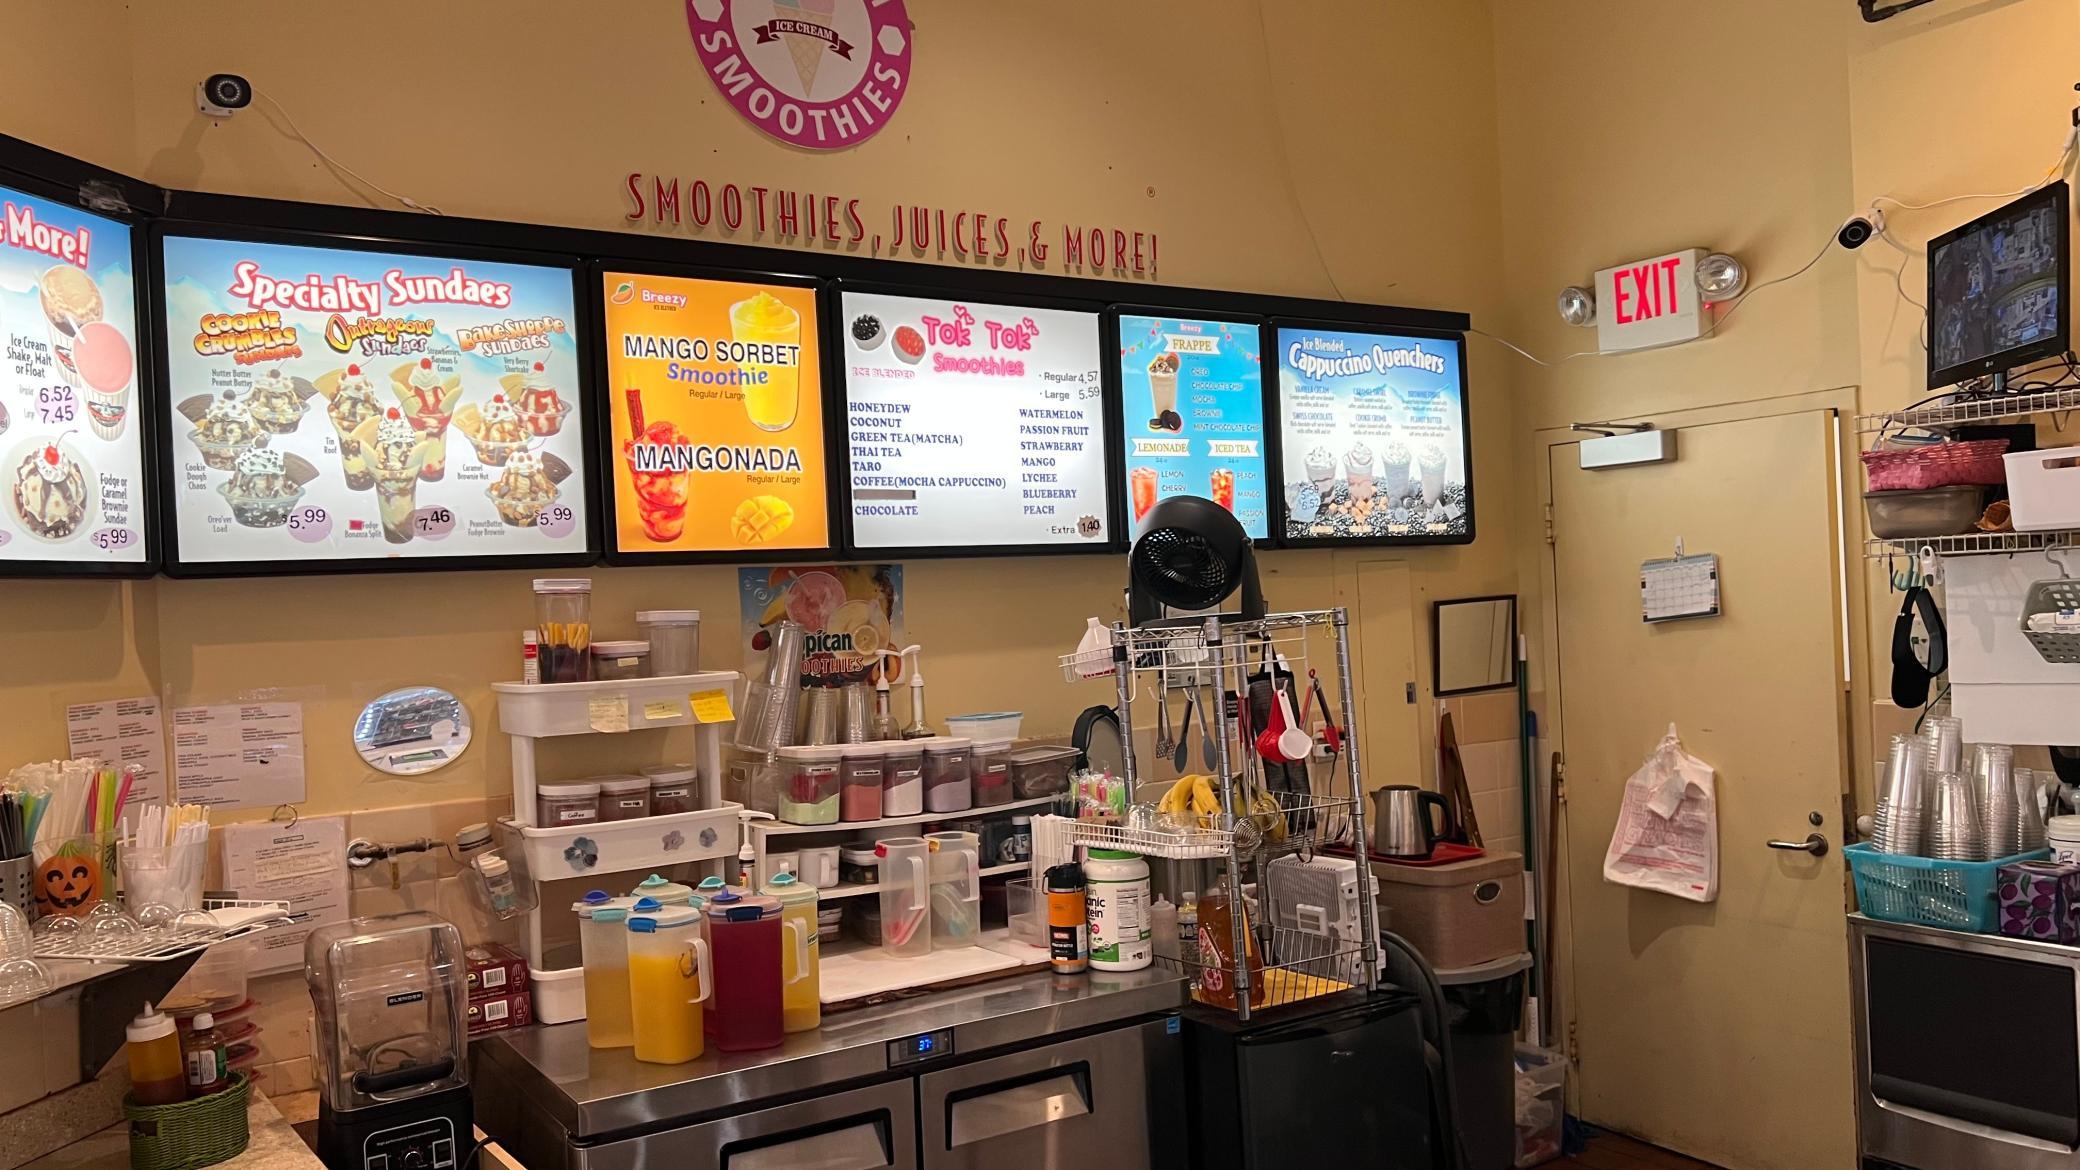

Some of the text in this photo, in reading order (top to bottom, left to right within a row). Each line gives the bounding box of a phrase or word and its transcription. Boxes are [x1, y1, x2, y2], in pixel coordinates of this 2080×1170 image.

[775, 20, 833, 40] ICE CREAM
[700, 29, 901, 141] SMOOTHIES
[6, 203, 91, 269] More!
[1031, 221, 1048, 262] &
[1064, 224, 1157, 273] MORE!
[227, 260, 513, 316] Specialty Sundaes
[1613, 257, 1681, 325] EXIT
[641, 289, 687, 308] Breezy
[922, 314, 1032, 351] Tok Tok
[11, 333, 47, 351] Ice Cream
[1173, 338, 1212, 351] FRAPPE
[1302, 337, 1344, 353] Ice Blended
[7, 347, 52, 366] Shake, Malt
[624, 335, 799, 366] MANGO SORBET
[933, 352, 1025, 376] Smoothies
[1288, 341, 1445, 381] Cappuccino Quenchers
[16, 364, 46, 378] or Float
[667, 363, 768, 386] Smoothie
[1044, 371, 1098, 384] Regular 4.57
[1191, 368, 1208, 376] OREO
[1191, 382, 1227, 390] CHOCOLATE
[39, 385, 73, 403] 6.52
[689, 389, 718, 400] Regular
[725, 390, 745, 401] Large
[1045, 386, 1100, 401] Large 5.59
[849, 402, 911, 413] HONEYDEW
[1019, 408, 1084, 420] WATERMELON
[40, 405, 74, 424] 7.45
[850, 417, 902, 428] COCONUT
[1020, 425, 1089, 435] PASSION FRUIT
[851, 432, 963, 446] GREEN TEA(MATCHA)
[852, 447, 902, 457] THAI TEA
[1020, 441, 1084, 451] STRAWBERRY
[1138, 443, 1187, 453] LEMONADE
[1215, 444, 1250, 453] ICED TEA
[635, 445, 802, 471] MANGONADA
[1022, 457, 1056, 466] MANGO
[185, 463, 206, 472] Cookie
[852, 461, 882, 471] TARO
[100, 472, 128, 488] Fudge or
[187, 472, 207, 482] Dough
[746, 474, 774, 485] Regular
[781, 475, 801, 484] Large
[938, 477, 1006, 489] CAPPUCCINO)
[1022, 473, 1058, 483] LYCHEE
[188, 482, 207, 490] Chaos
[101, 487, 127, 501] Caramel
[1023, 489, 1077, 499] BLUEBERRY
[101, 501, 129, 513] Brownie
[854, 505, 919, 516] CHOCOLATE
[1023, 505, 1055, 515] PEACH
[104, 512, 127, 525] Sundae
[419, 509, 450, 531] 7.46
[1051, 526, 1076, 535] Extra
[801, 657, 863, 675] OOTHIES
[1088, 897, 1105, 907] anic
[1088, 907, 1103, 918] tein
[389, 994, 421, 1003] BLENDER
